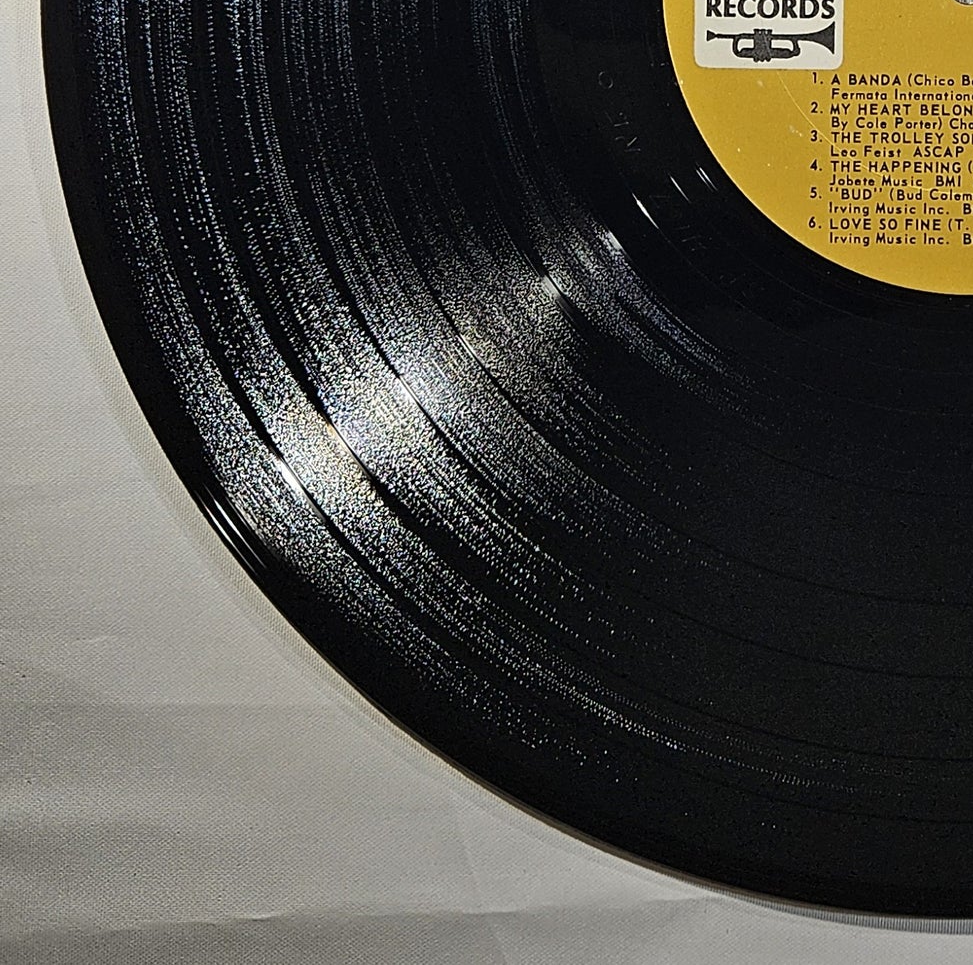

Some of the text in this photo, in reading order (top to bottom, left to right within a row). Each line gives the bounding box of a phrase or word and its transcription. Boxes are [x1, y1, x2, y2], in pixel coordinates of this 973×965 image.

[813, 72, 823, 84] 1.
[831, 74, 840, 85] A
[849, 74, 901, 85] BANDA
[908, 74, 954, 86] (Chico
[832, 88, 887, 100] Fermata
[811, 102, 823, 113] 2.
[830, 104, 850, 114] MY
[858, 104, 911, 115] HEART
[832, 117, 848, 131] By
[856, 117, 886, 129] Cole
[895, 117, 942, 130] Porter)
[811, 130, 822, 142] 3.
[831, 132, 861, 143] THE
[870, 132, 943, 144] TROLLEY
[831, 145, 856, 157] Leo
[864, 146, 901, 157] Feist
[913, 146, 964, 157] ASCAP
[810, 160, 822, 171] 4.
[831, 161, 861, 172] THE
[869, 161, 961, 173] HAPPENING
[830, 174, 874, 186] Jobete
[882, 175, 922, 186] Music
[936, 175, 961, 187] BMI
[810, 187, 821, 198] 5.
[830, 187, 882, 200] "BUD"
[890, 188, 922, 201] (Bud
[830, 202, 869, 216] Irving
[876, 203, 915, 214] Music
[924, 203, 949, 214] Inc.
[809, 217, 821, 228] 6.
[830, 218, 871, 230] LOVE
[879, 219, 897, 230] SO
[905, 219, 941, 230] FINE
[948, 219, 968, 231] (T.
[830, 232, 869, 246] Irving
[876, 233, 916, 244] Music
[924, 233, 949, 244] Inc.
